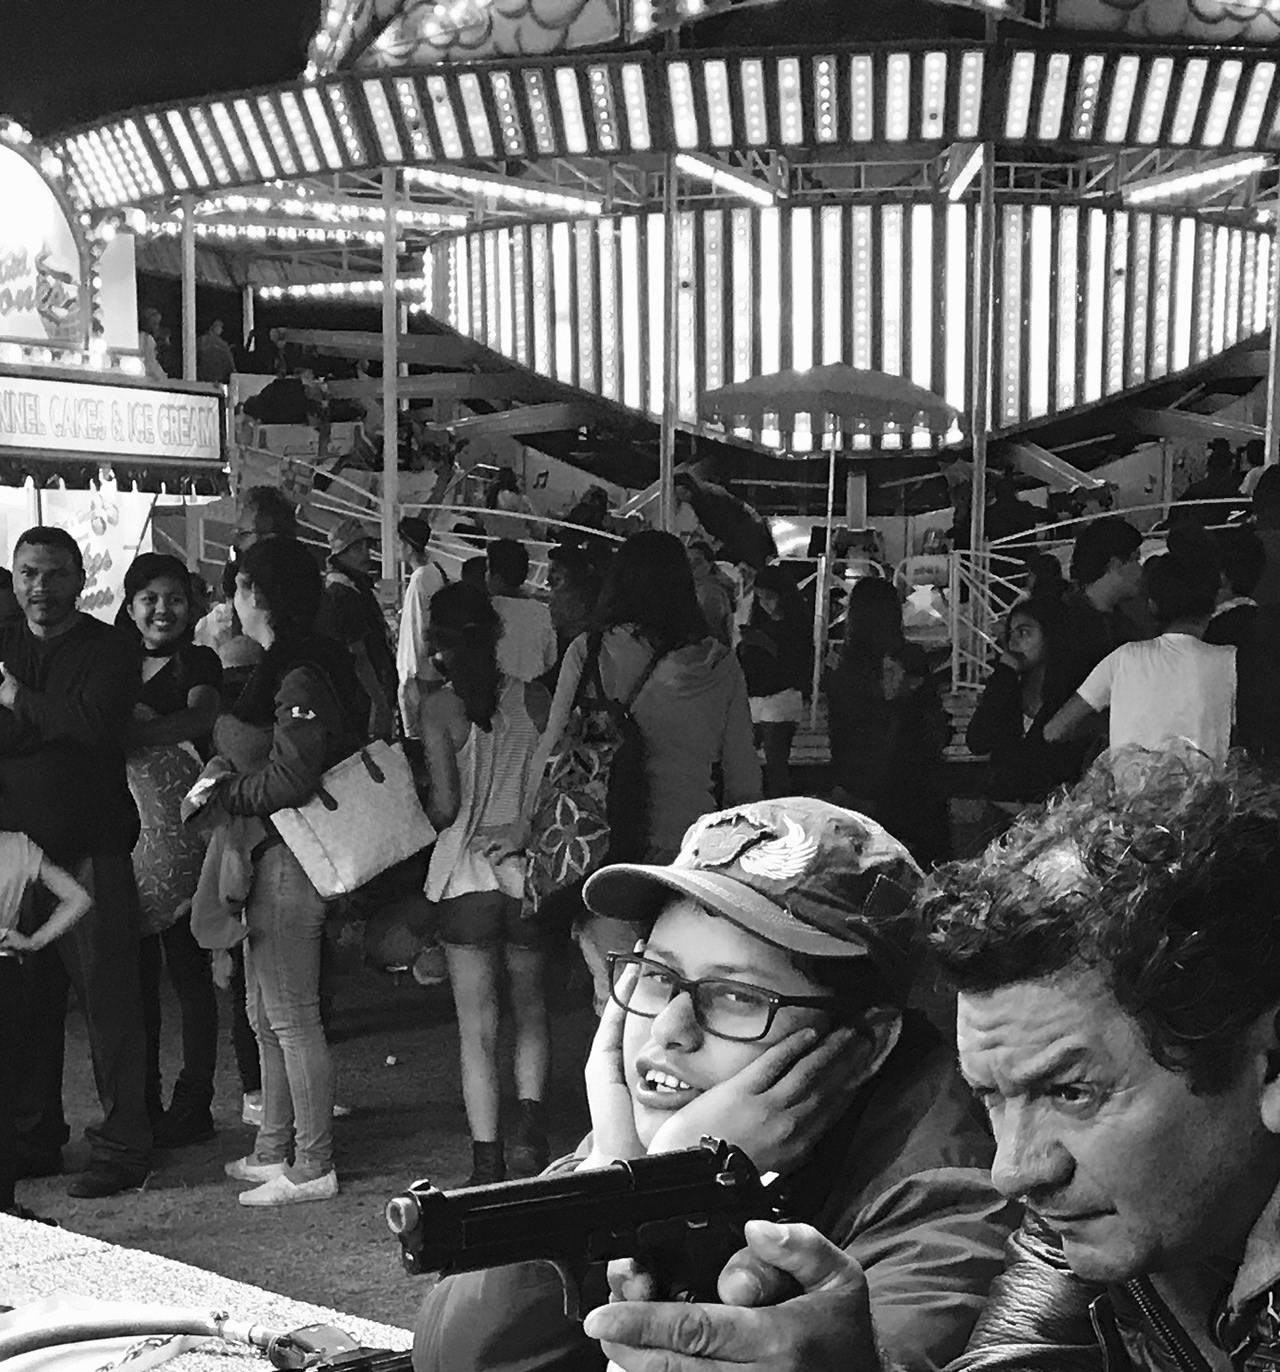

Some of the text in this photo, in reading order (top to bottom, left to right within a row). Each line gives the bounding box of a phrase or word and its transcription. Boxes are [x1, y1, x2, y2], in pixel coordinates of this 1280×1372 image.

[49, 394, 107, 441] CAKES
[111, 399, 125, 442] &
[127, 401, 155, 444] ICE
[157, 403, 218, 448] CREAM
